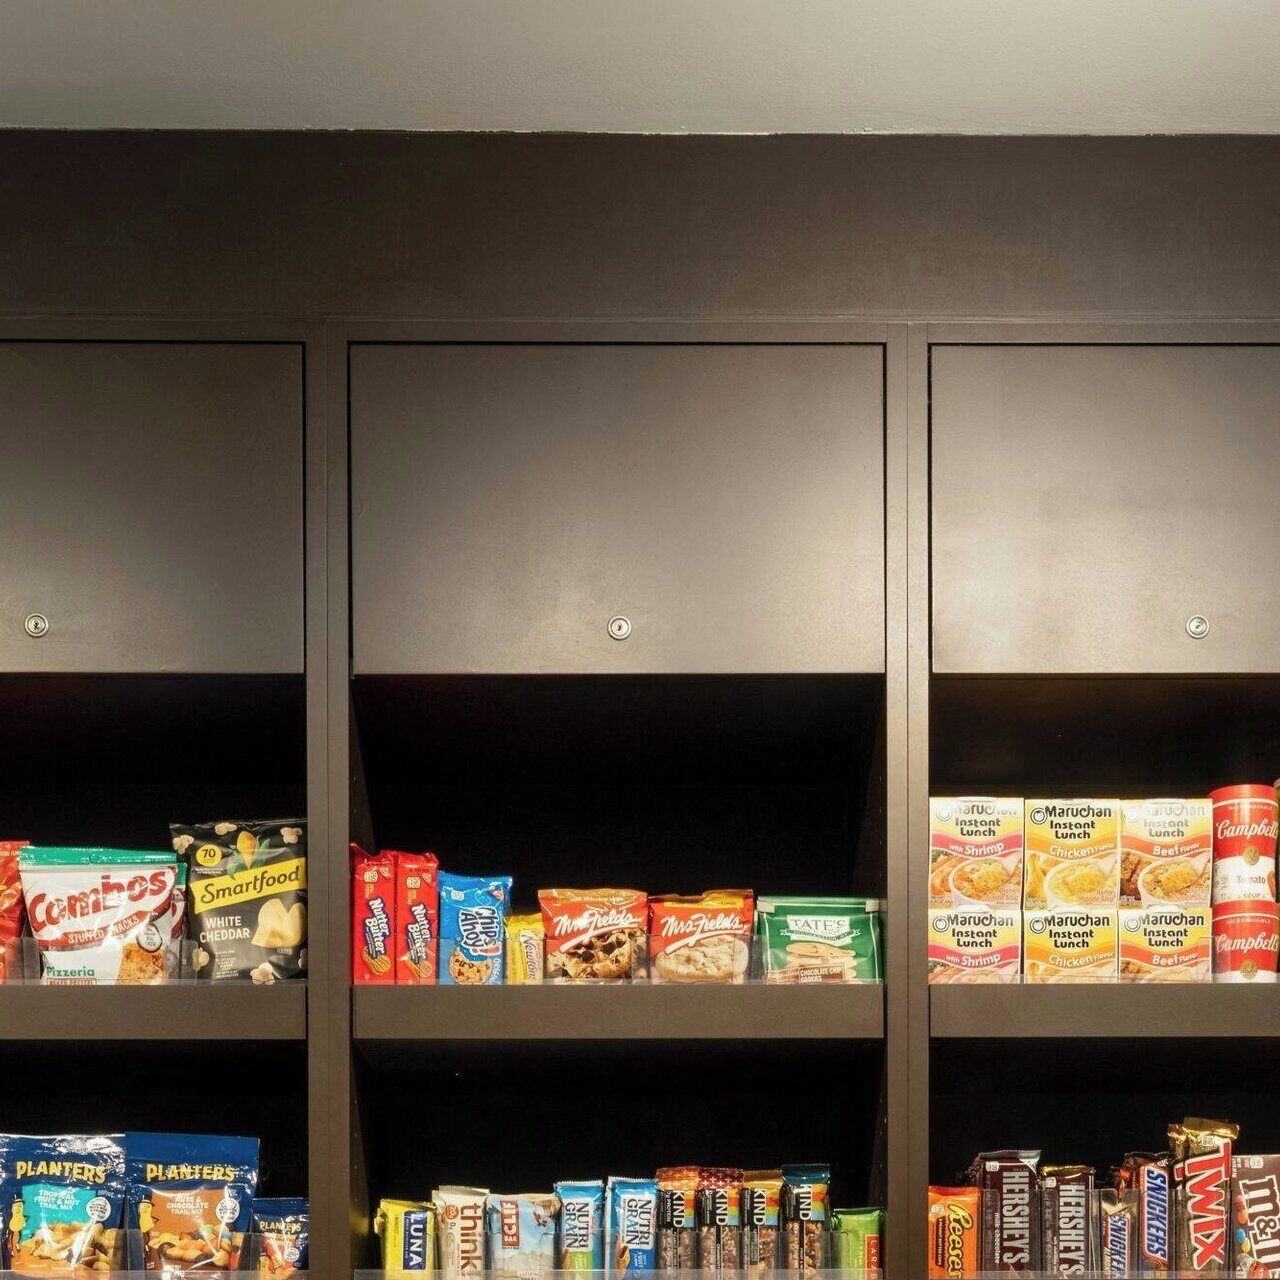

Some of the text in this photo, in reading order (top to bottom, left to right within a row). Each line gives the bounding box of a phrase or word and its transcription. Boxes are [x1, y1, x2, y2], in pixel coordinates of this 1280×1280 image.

[1045, 804, 1112, 819] Maruchan
[955, 817, 1001, 827] Instant
[1050, 820, 1096, 830] Instant
[960, 827, 996, 837] Lunch
[1055, 830, 1091, 840] Lunch
[1148, 828, 1185, 838] Lunch
[202, 848, 216, 859] 70
[964, 841, 1005, 857] Shrimp
[1050, 844, 1094, 858] Chicken
[1153, 844, 1180, 857] Beef
[201, 865, 300, 904] Smartfood
[28, 871, 167, 932] Combos
[205, 916, 242, 929] WHITE
[368, 898, 390, 936] Nutter
[411, 903, 431, 942] Nutter
[947, 913, 1014, 926] Maruchan
[1043, 913, 1111, 927] Maruchan
[1138, 912, 1205, 926] Maruchan
[475, 906, 498, 947] Chips
[692, 910, 745, 944] Fields
[951, 927, 997, 938] Instant
[1049, 928, 1095, 939] Instant
[1143, 927, 1189, 938] Instant
[200, 928, 250, 943] CHEDDAR
[365, 917, 385, 955] Butter
[956, 938, 993, 948] Lunch
[1148, 938, 1184, 947] Lunch
[1054, 939, 1090, 948] Lunch
[961, 952, 1001, 967] Shrimp
[1048, 954, 1094, 967] Chicken
[1153, 953, 1180, 966] Beef
[46, 966, 95, 977] Pizzeria
[16, 1161, 106, 1184] PLANTERS
[146, 1163, 236, 1183] PLANTERS
[673, 1190, 685, 1228] KIND
[715, 1188, 728, 1227] KIND
[753, 1187, 766, 1227] KIND
[799, 1184, 812, 1221] KIND
[1185, 1140, 1232, 1271] TWIX
[502, 1201, 517, 1236] CLIF
[1002, 1171, 1030, 1266] HERSHEY'S
[1146, 1168, 1168, 1258] SNICKERS
[565, 1202, 578, 1249] GRAIN
[576, 1202, 590, 1249] NUTRI
[626, 1198, 639, 1246] GRAIN
[638, 1199, 652, 1246] NUTRI
[1059, 1184, 1086, 1279] HERSHEY'S
[409, 1213, 424, 1267] LUNA
